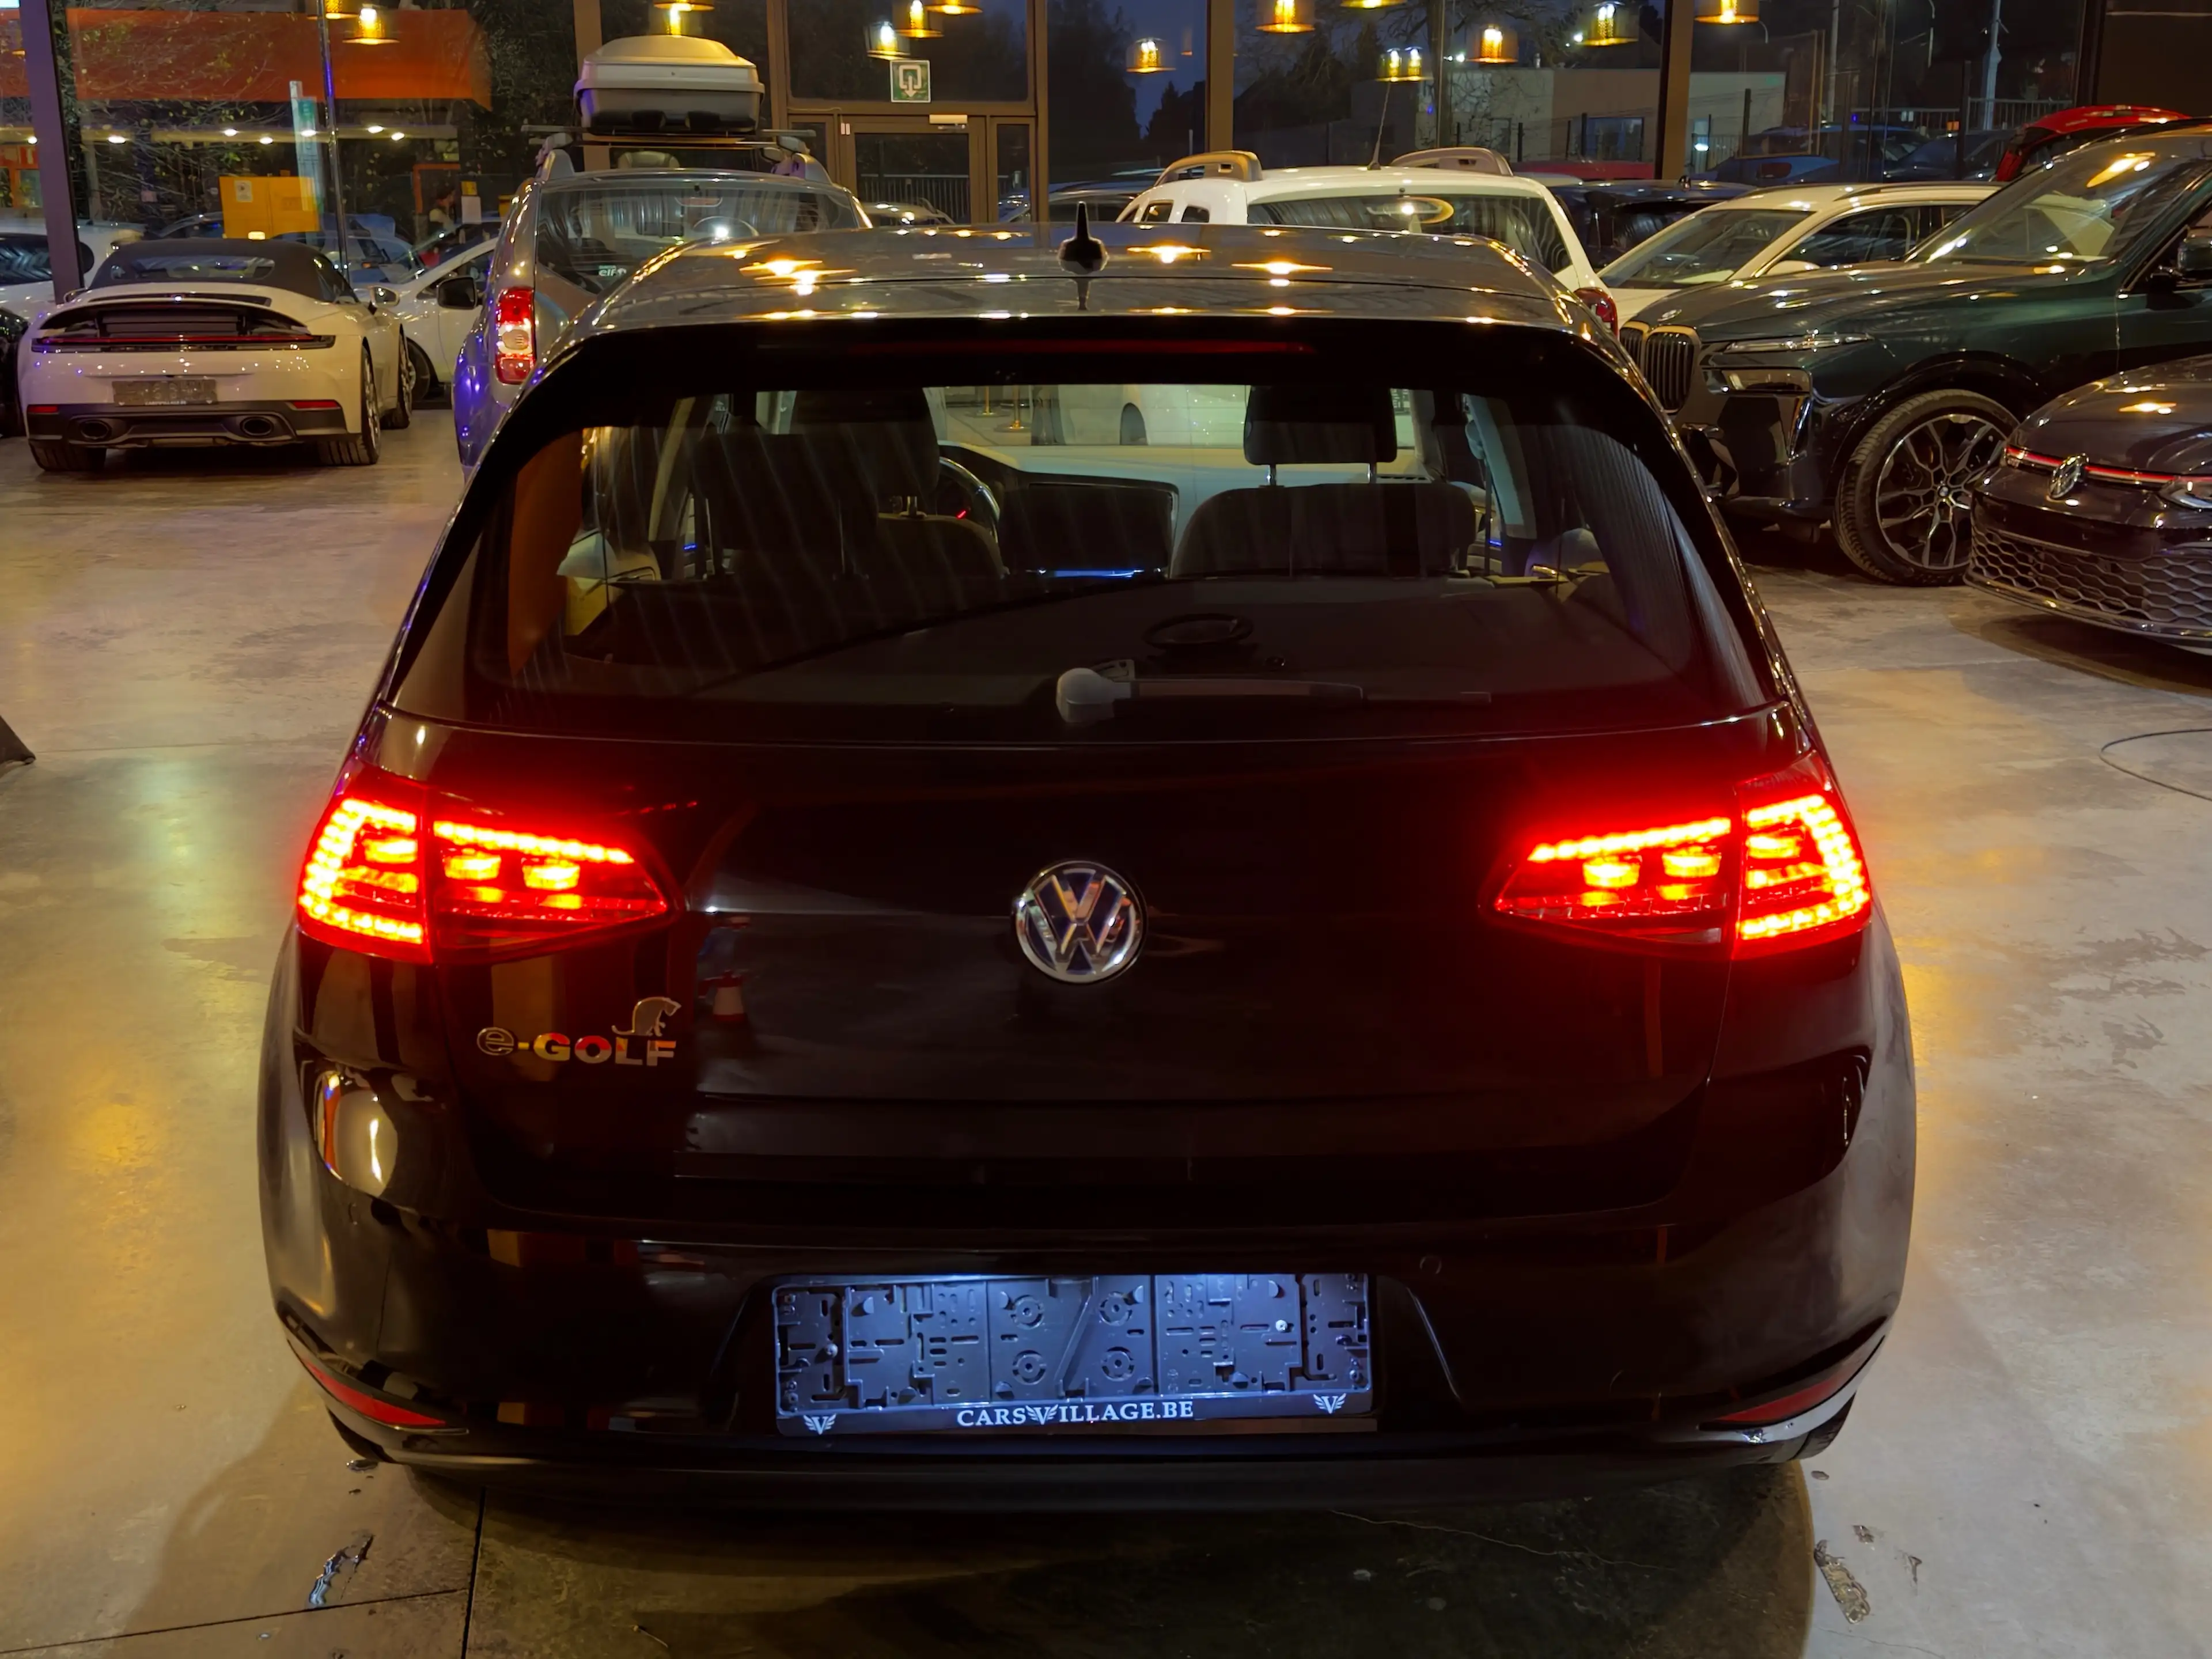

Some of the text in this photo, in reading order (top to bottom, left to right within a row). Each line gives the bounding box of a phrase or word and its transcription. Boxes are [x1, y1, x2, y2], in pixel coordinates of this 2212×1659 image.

[1018, 866, 1138, 980] VW
[476, 1027, 677, 1066] e-GOLF
[957, 1401, 1194, 1427] CARSVILLAGE.BE
